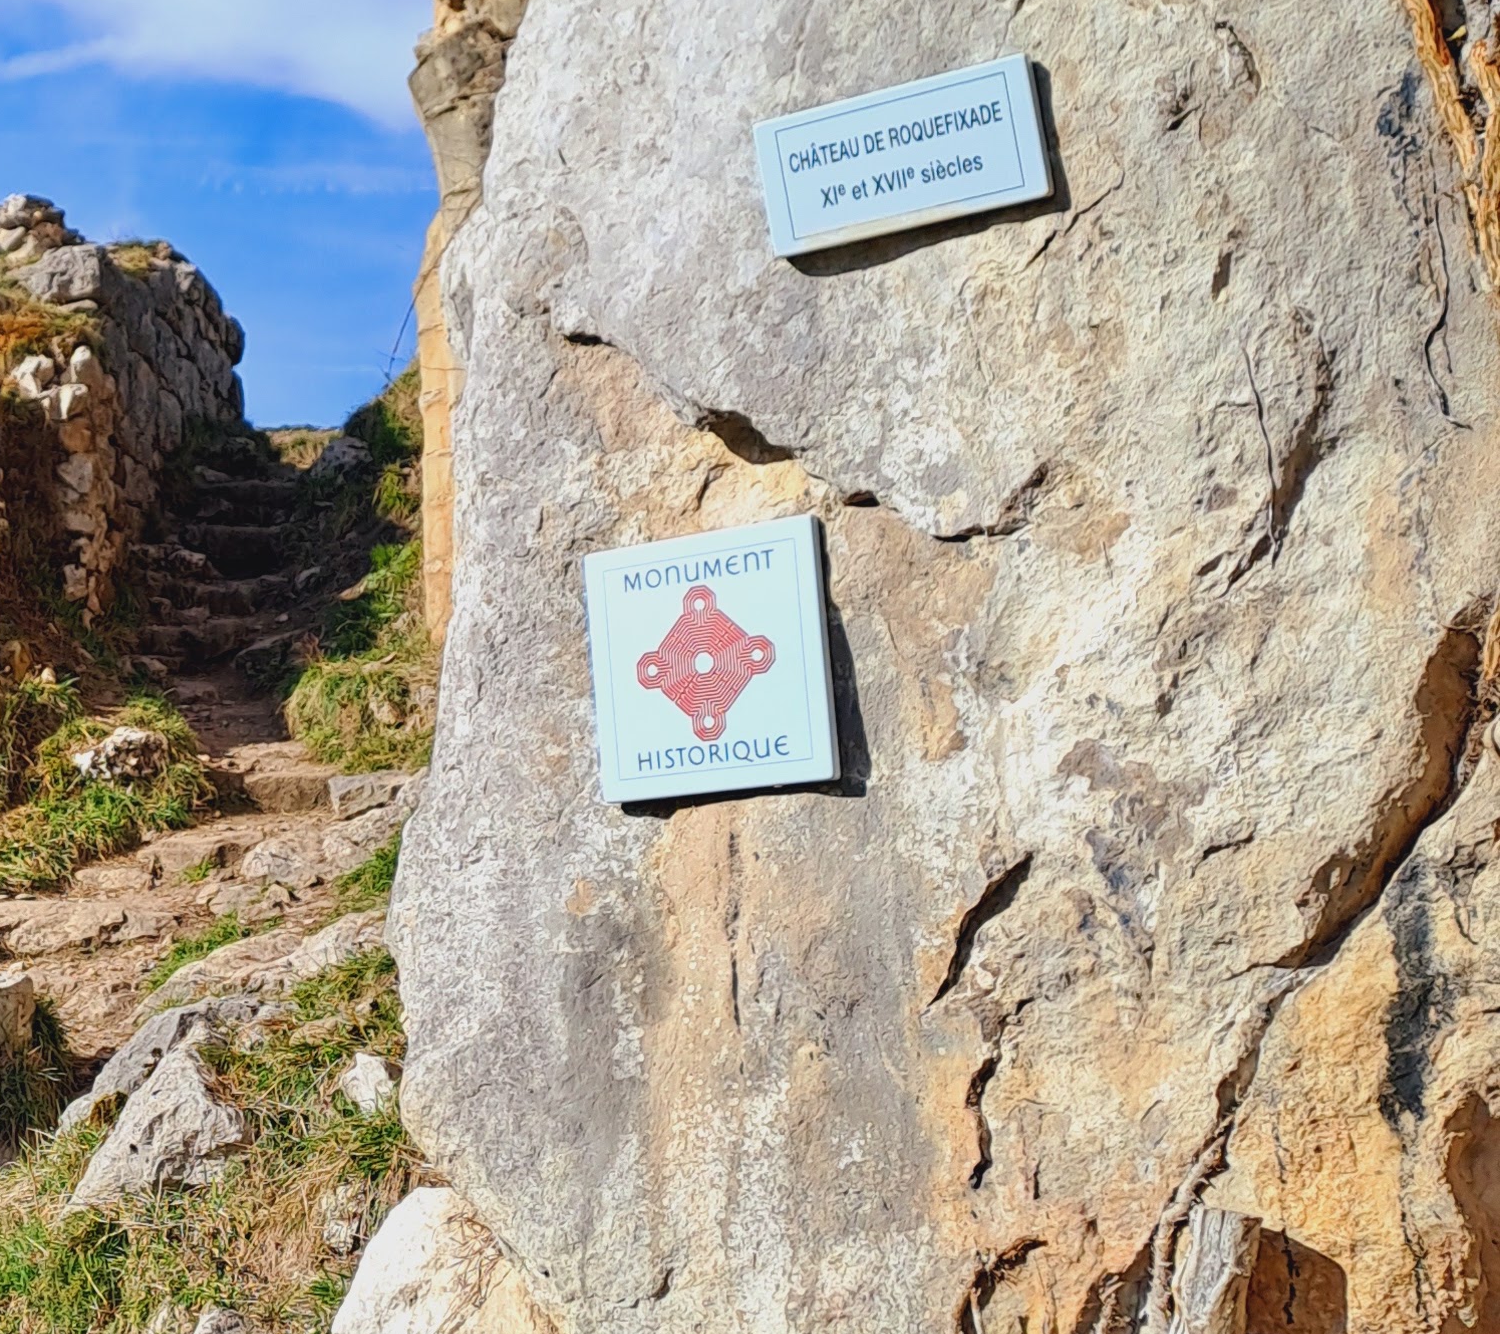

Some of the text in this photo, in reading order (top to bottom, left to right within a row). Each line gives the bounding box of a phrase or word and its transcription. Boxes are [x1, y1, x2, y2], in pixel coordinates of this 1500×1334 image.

[789, 101, 1003, 173] CHÂTEAU DE ROQUEFIXADE
[852, 178, 869, 200] et
[921, 154, 984, 184] siècles
[623, 548, 775, 593] MONUMENT
[637, 735, 790, 772] HISTORIQUE
